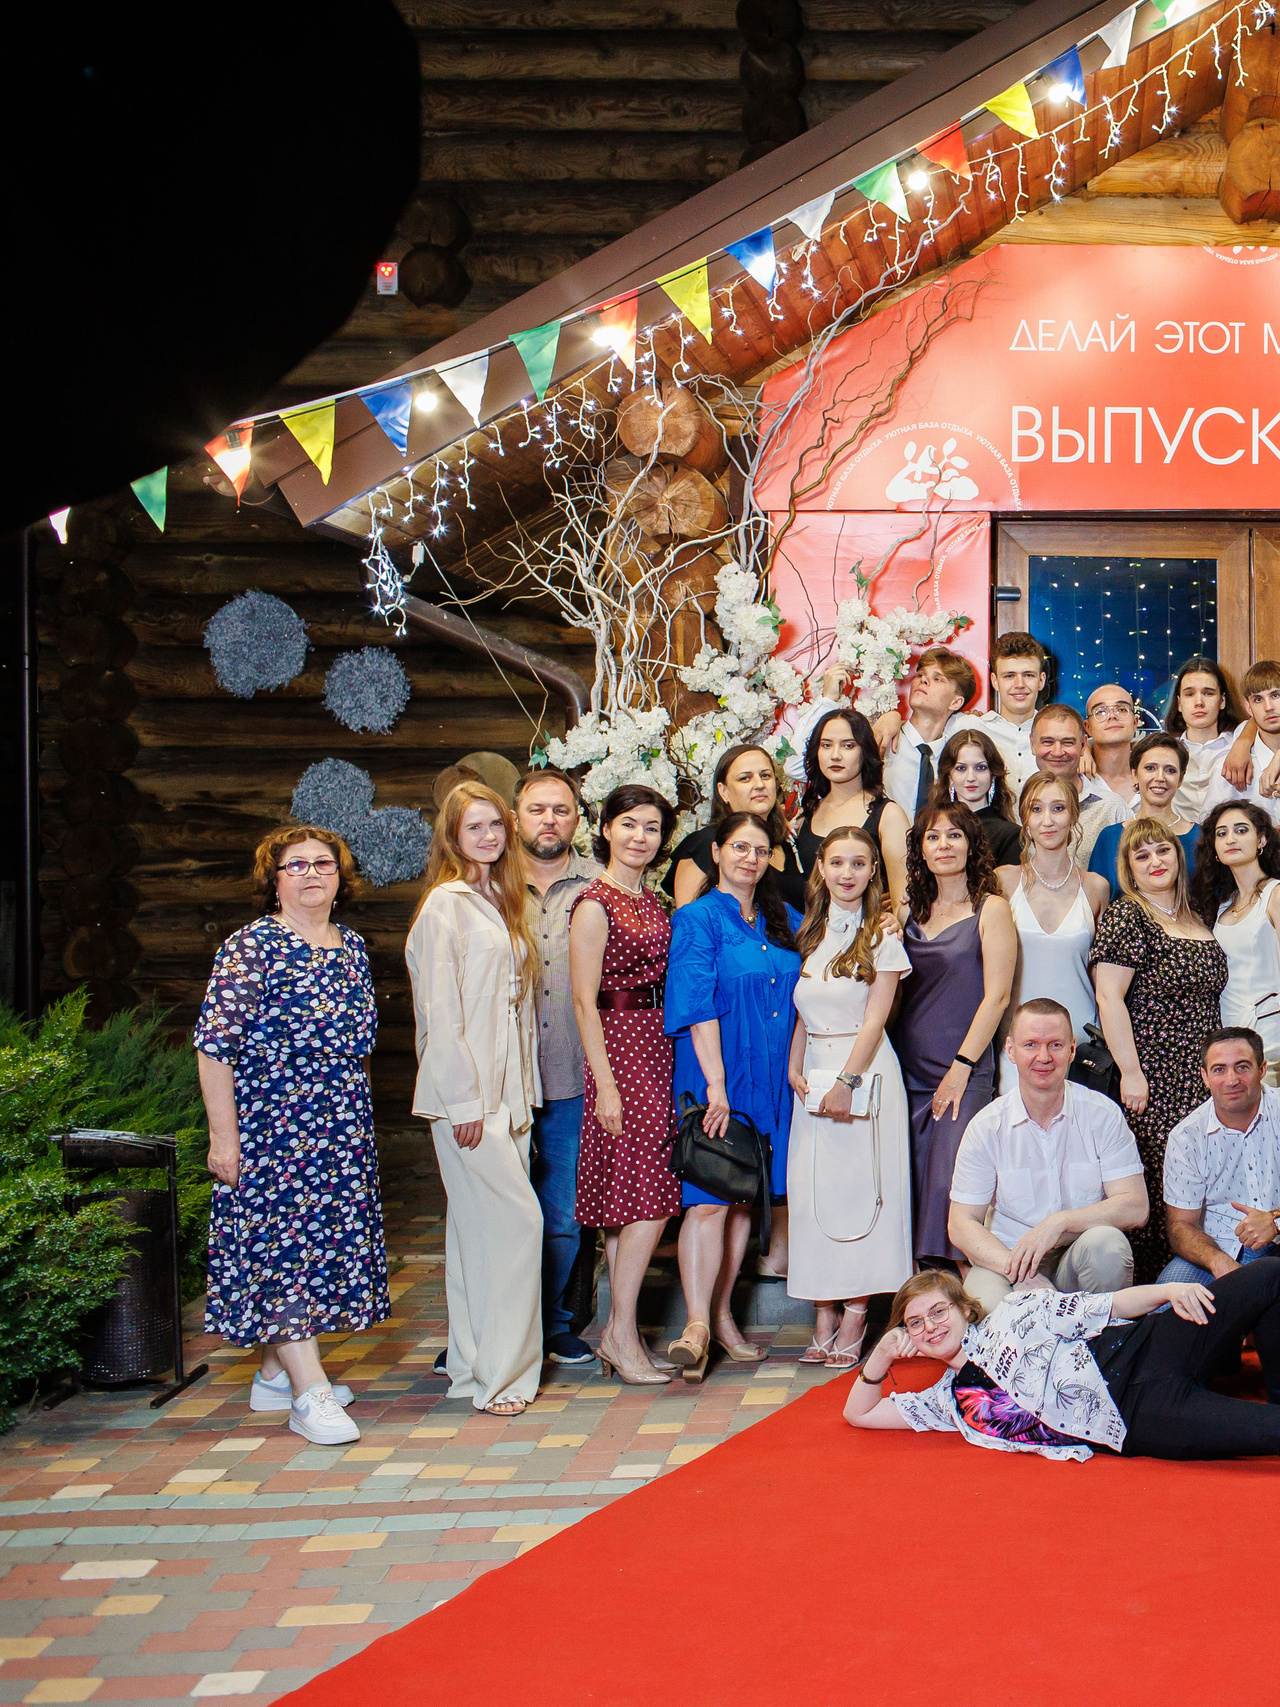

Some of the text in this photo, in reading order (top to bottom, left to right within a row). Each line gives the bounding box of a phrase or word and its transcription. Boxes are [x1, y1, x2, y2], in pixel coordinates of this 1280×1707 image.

[1009, 313, 1136, 352] ДЕЛАЙ
[1154, 320, 1246, 354] ЭТОТ
[825, 421, 1023, 511] ЮТНАЯ БАЗА ОТДЫХА УЮТНАЯ БАЗА ОТДЫХА УЮТНАЯ БАЗА ОТДЫХА
[934, 554, 947, 580] ОТДЫХА
[1067, 1294, 1080, 1316] PARTY
[994, 1345, 1012, 1375] ALOHA
[1001, 1348, 1018, 1379] PARTY
